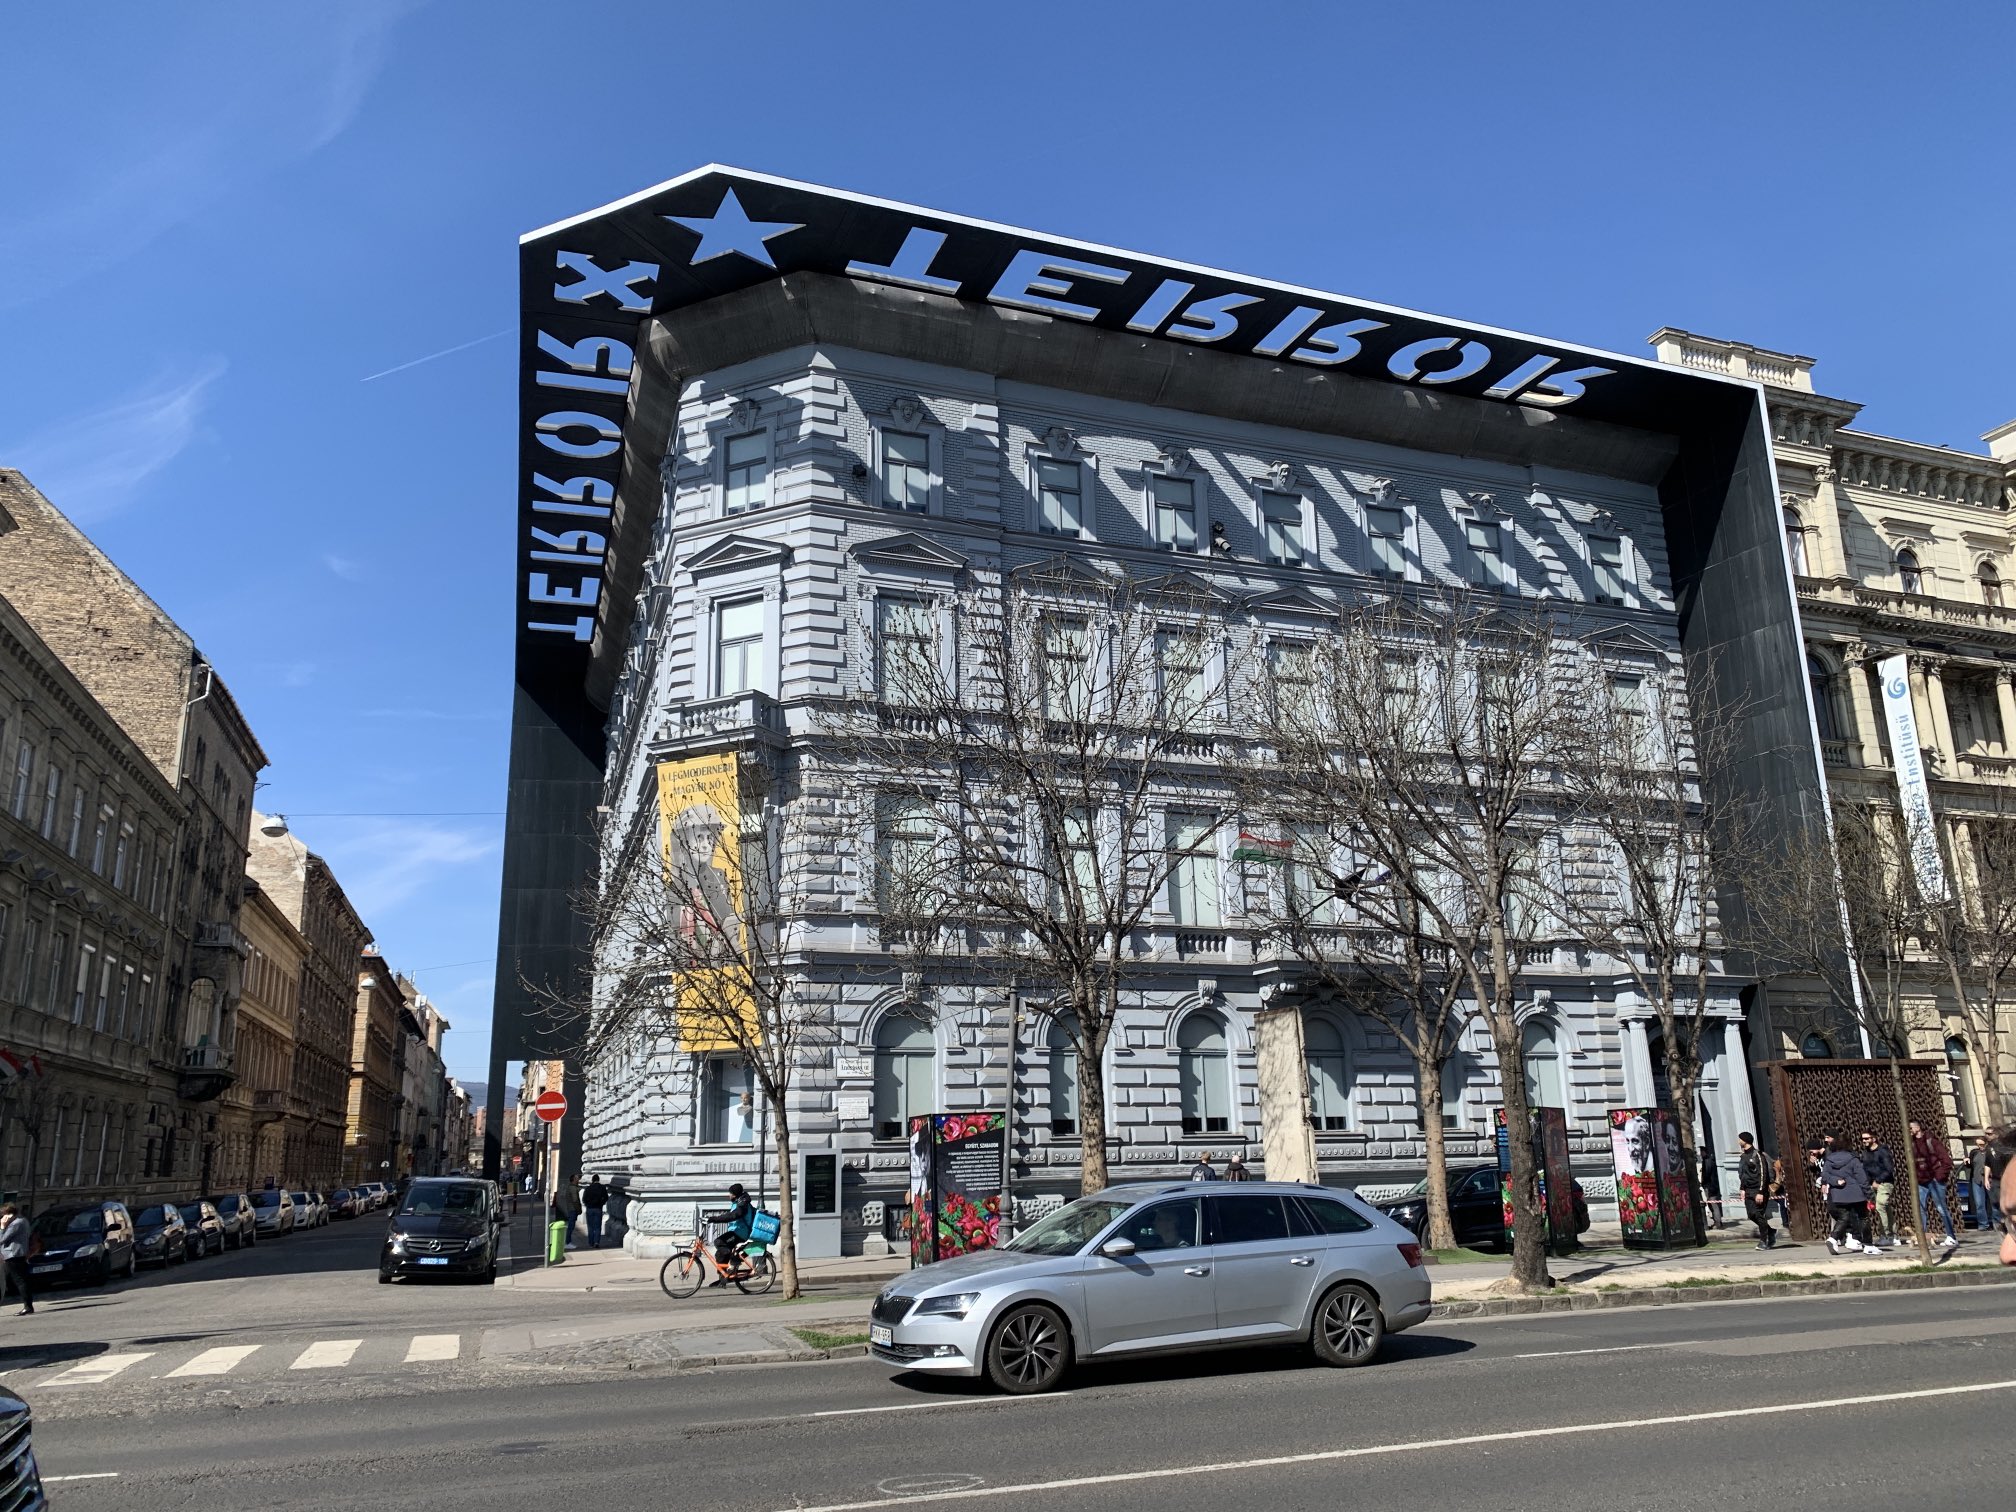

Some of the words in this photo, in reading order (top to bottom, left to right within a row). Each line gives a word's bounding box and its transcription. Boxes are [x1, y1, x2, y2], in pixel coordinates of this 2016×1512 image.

[660, 773, 667, 783] A
[668, 763, 734, 782] LEGMODERNEBB
[1895, 713, 1920, 787] Enstitüsü
